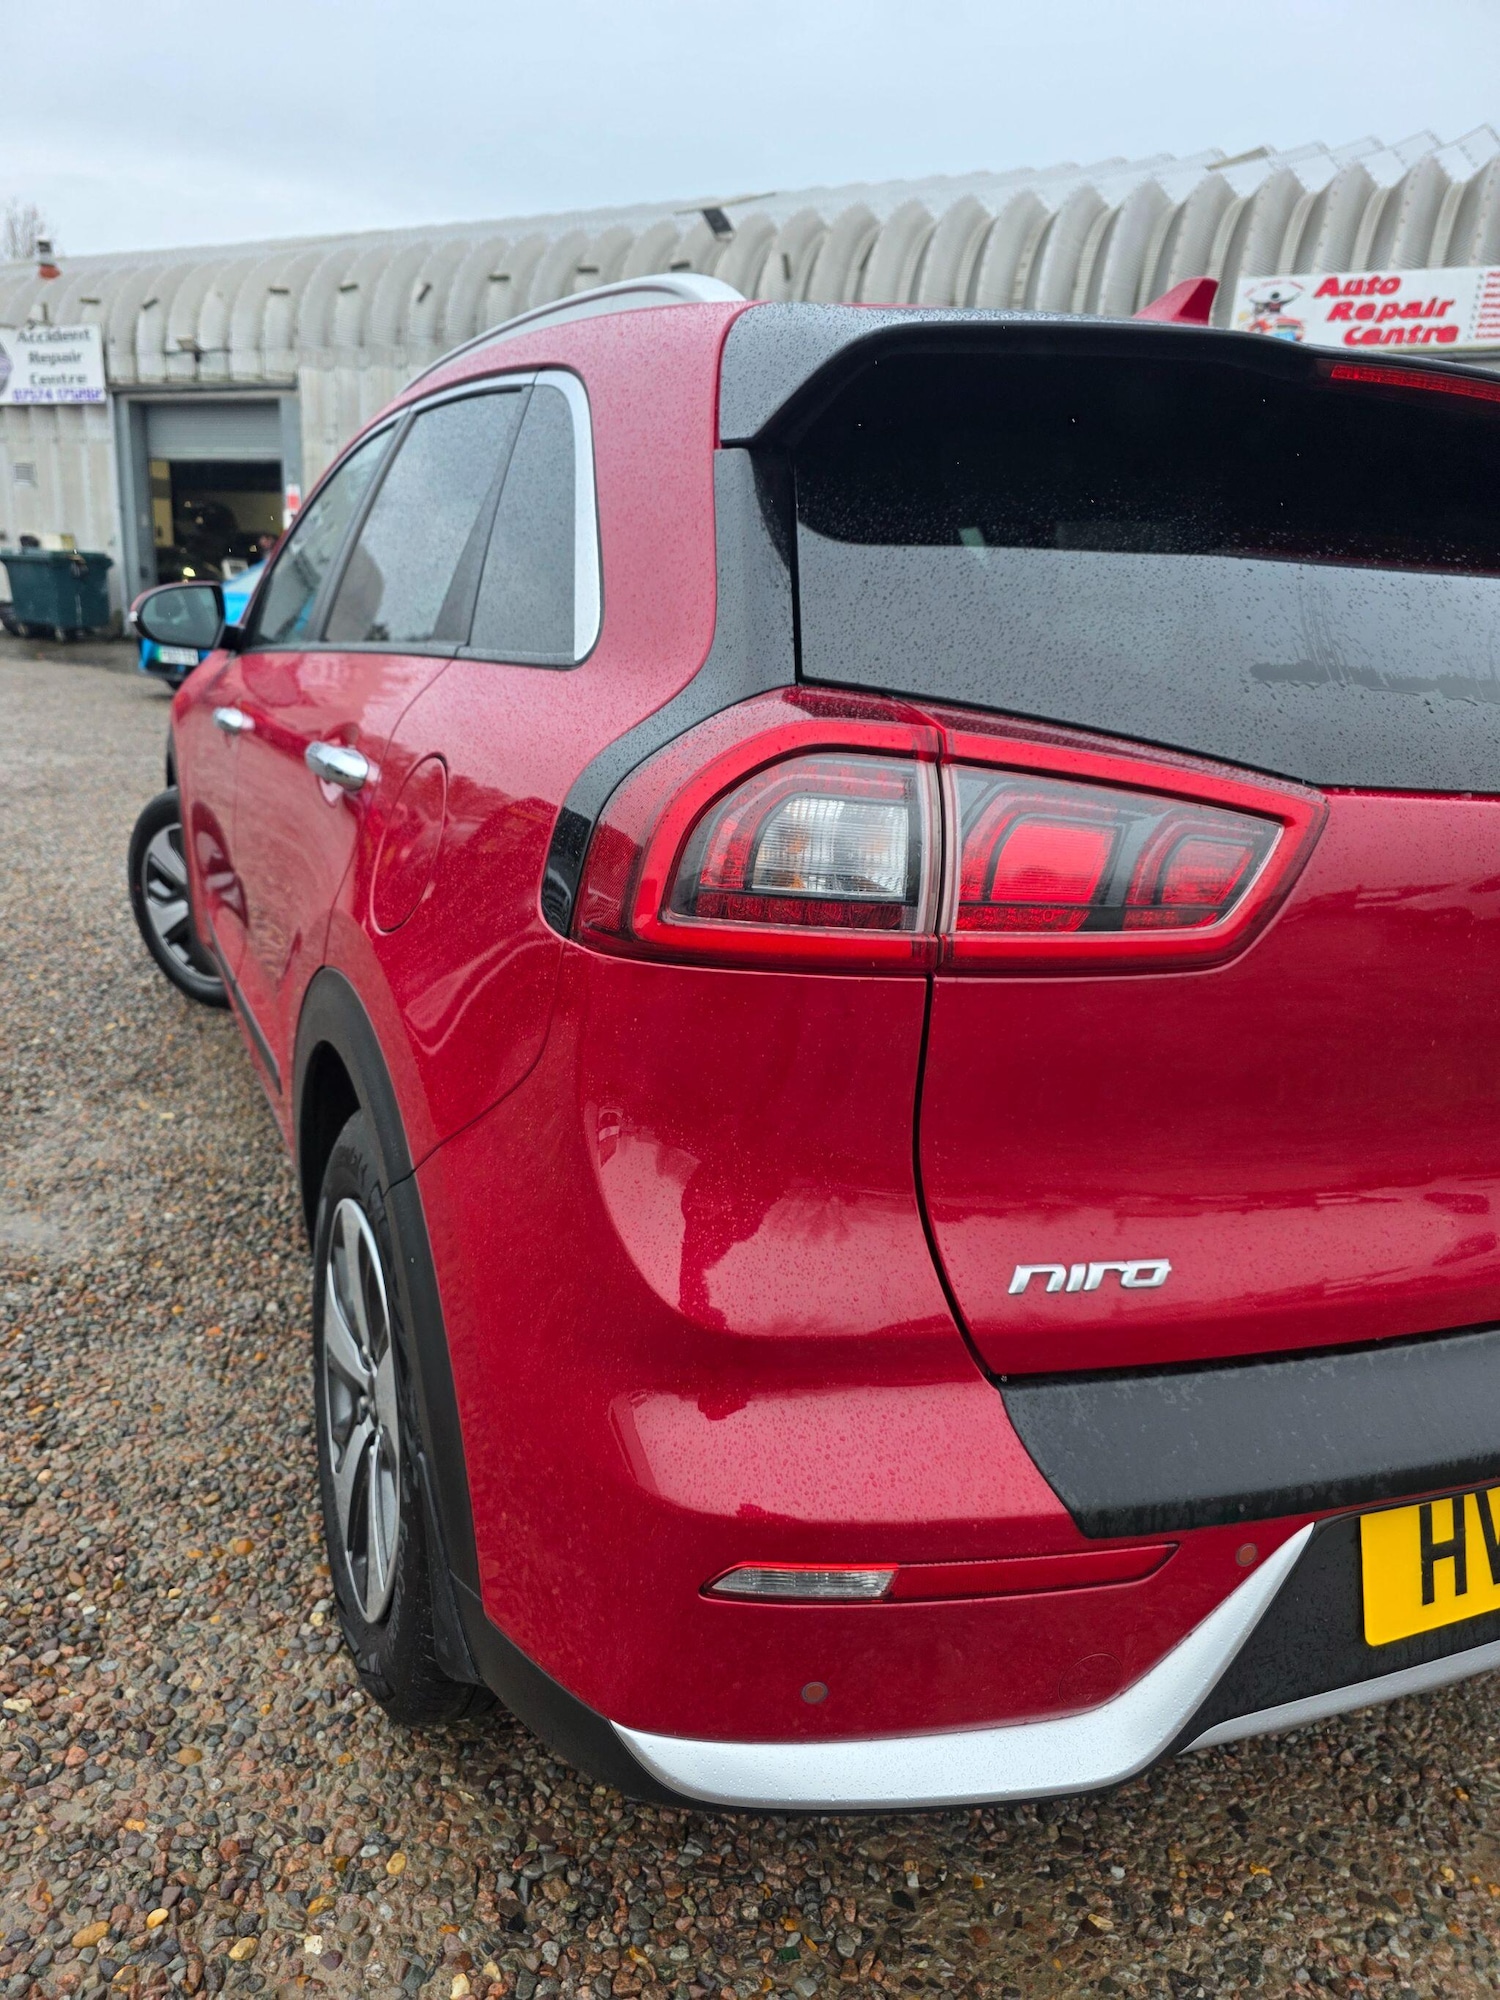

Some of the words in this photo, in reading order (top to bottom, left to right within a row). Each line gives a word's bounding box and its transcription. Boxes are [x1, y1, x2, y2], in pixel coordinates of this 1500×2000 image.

[1313, 276, 1402, 298] Auto
[1327, 298, 1455, 323] Repair
[17, 328, 90, 342] Accident
[1343, 324, 1460, 346] Centre
[28, 351, 82, 366] Repair
[30, 372, 87, 384] Centre
